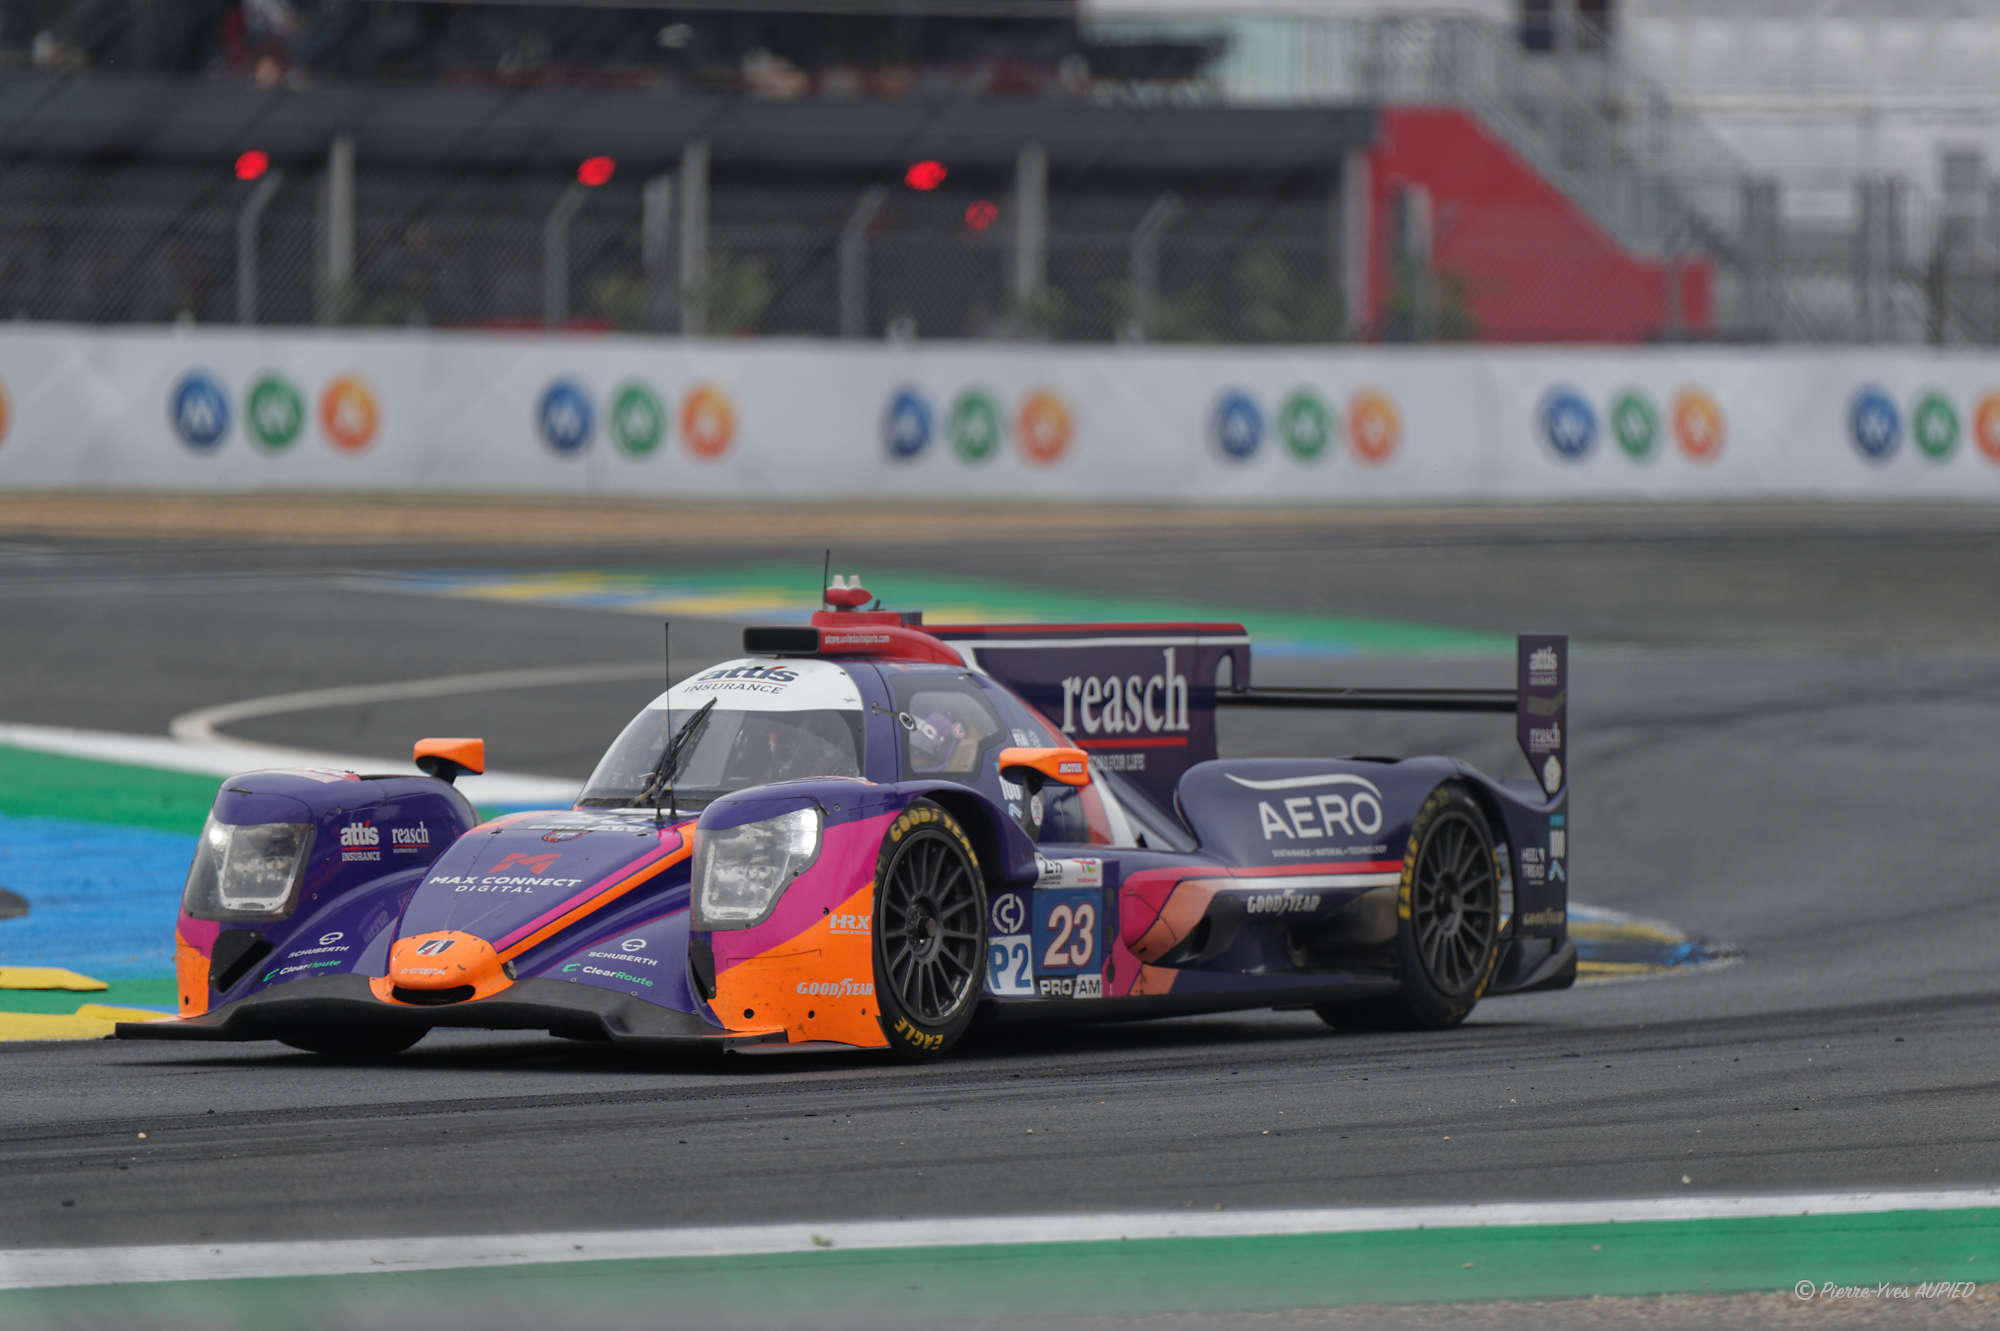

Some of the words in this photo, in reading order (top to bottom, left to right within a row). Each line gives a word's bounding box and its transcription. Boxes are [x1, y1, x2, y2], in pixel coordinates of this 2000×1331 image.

[697, 665, 799, 682] attis
[684, 683, 783, 695] INSURANCE
[1061, 647, 1190, 734] reasch
[1258, 791, 1383, 840] AERO
[340, 819, 380, 846] attis
[391, 820, 430, 844] reasch
[889, 806, 979, 868] GOODYEAR
[341, 852, 381, 862] INSURANCE
[429, 876, 478, 885] MAX
[481, 876, 582, 888] CONNECT
[454, 885, 534, 894] DIGITAL
[1247, 888, 1321, 917] GOODYEAR
[1041, 902, 1096, 968] 23
[588, 951, 659, 967] SCHUBERTH
[989, 942, 1032, 990] P2
[582, 966, 654, 987] ClearRoute
[1040, 979, 1073, 996] PRO
[1078, 979, 1100, 995] AM
[796, 978, 873, 1000] GOODYEAR
[894, 1016, 944, 1050] EAGLE
